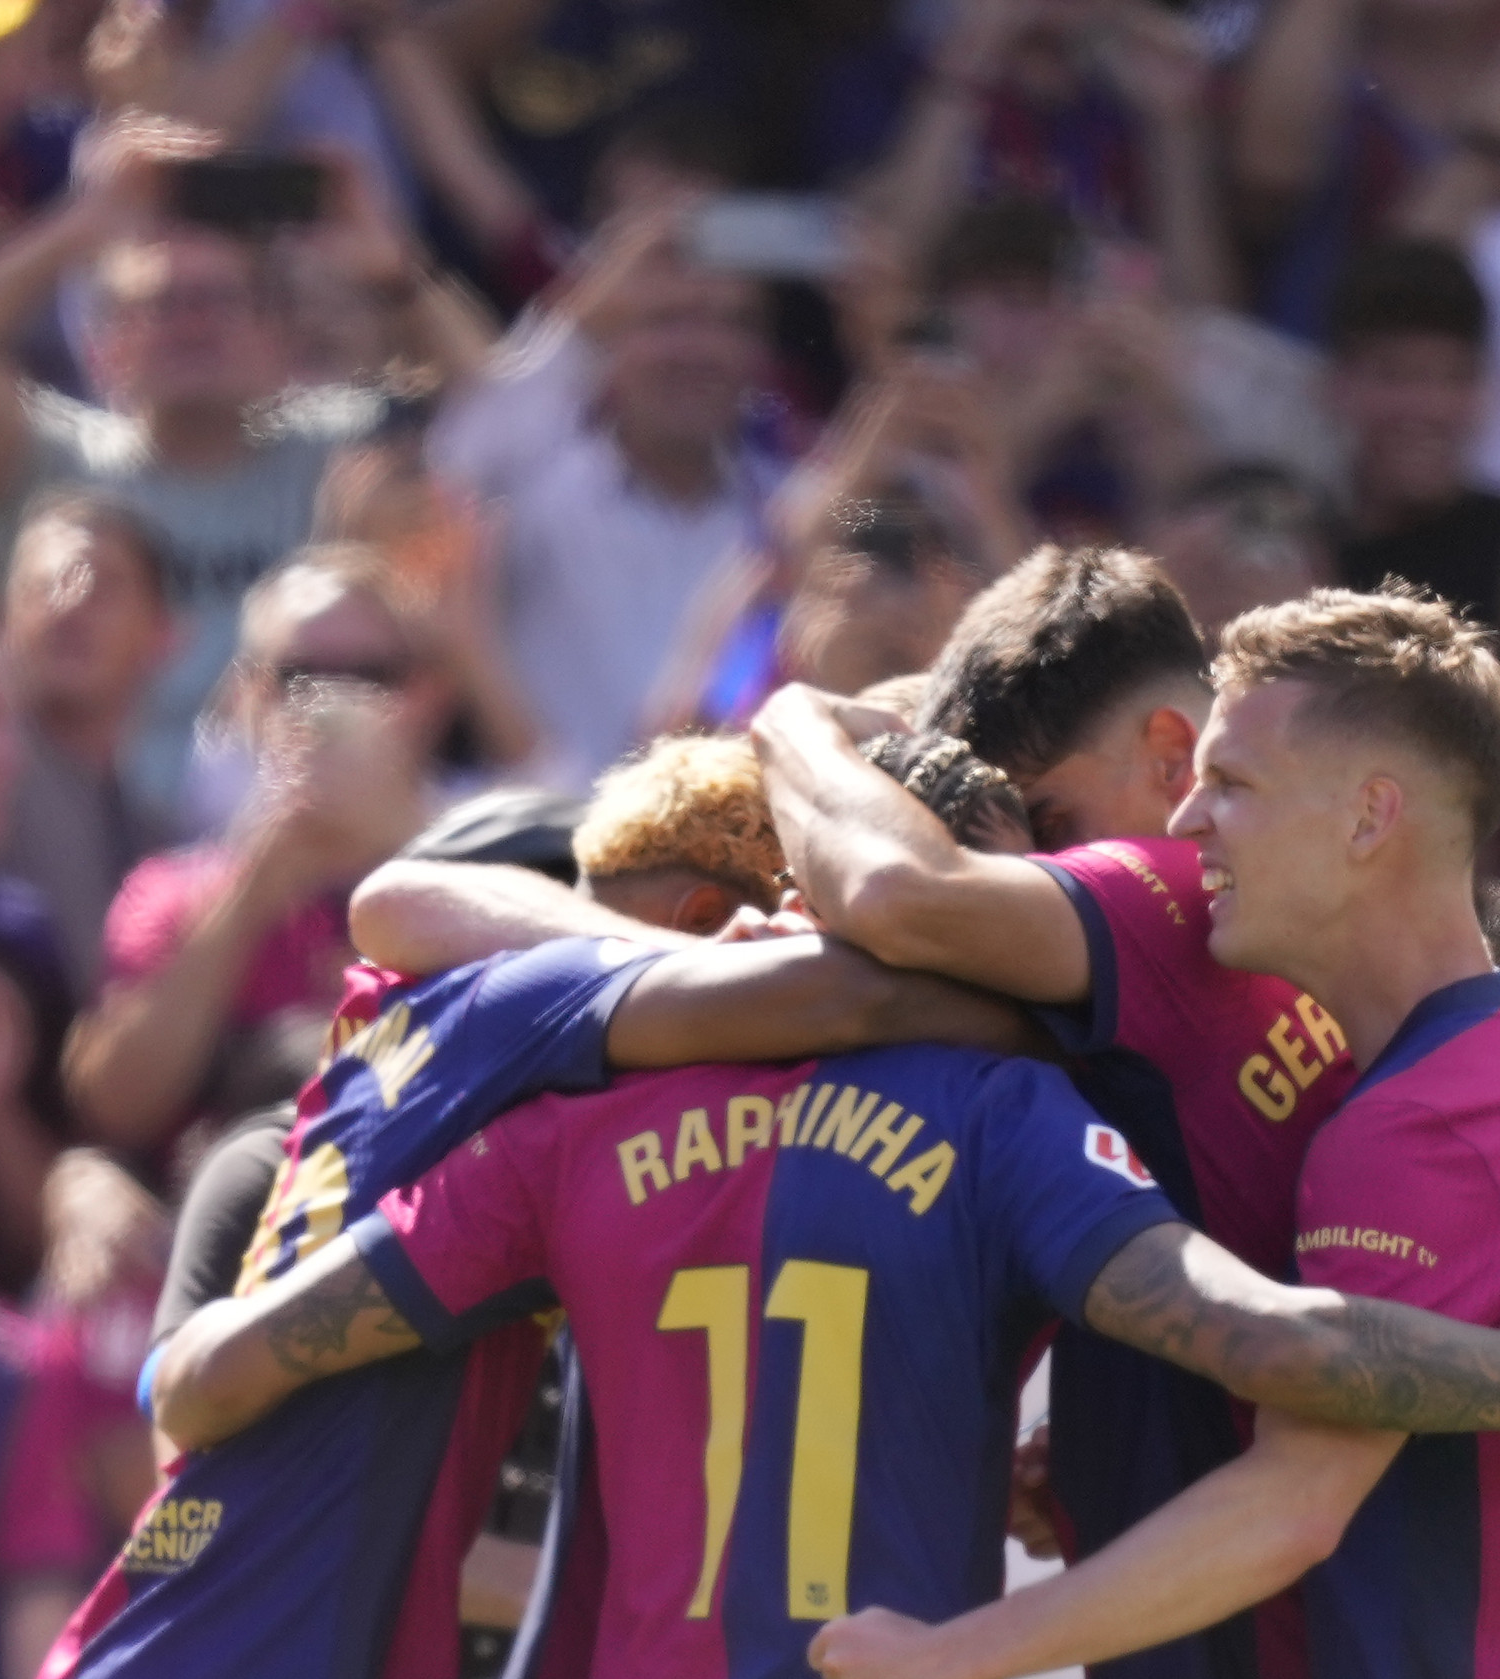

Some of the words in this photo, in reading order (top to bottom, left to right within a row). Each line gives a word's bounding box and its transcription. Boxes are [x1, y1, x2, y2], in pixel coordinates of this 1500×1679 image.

[617, 1082, 957, 1216] RAPHINHA
[1296, 1226, 1415, 1260] AMBILIGHT
[1417, 1245, 1438, 1268] tv
[656, 1259, 870, 1622] 11
